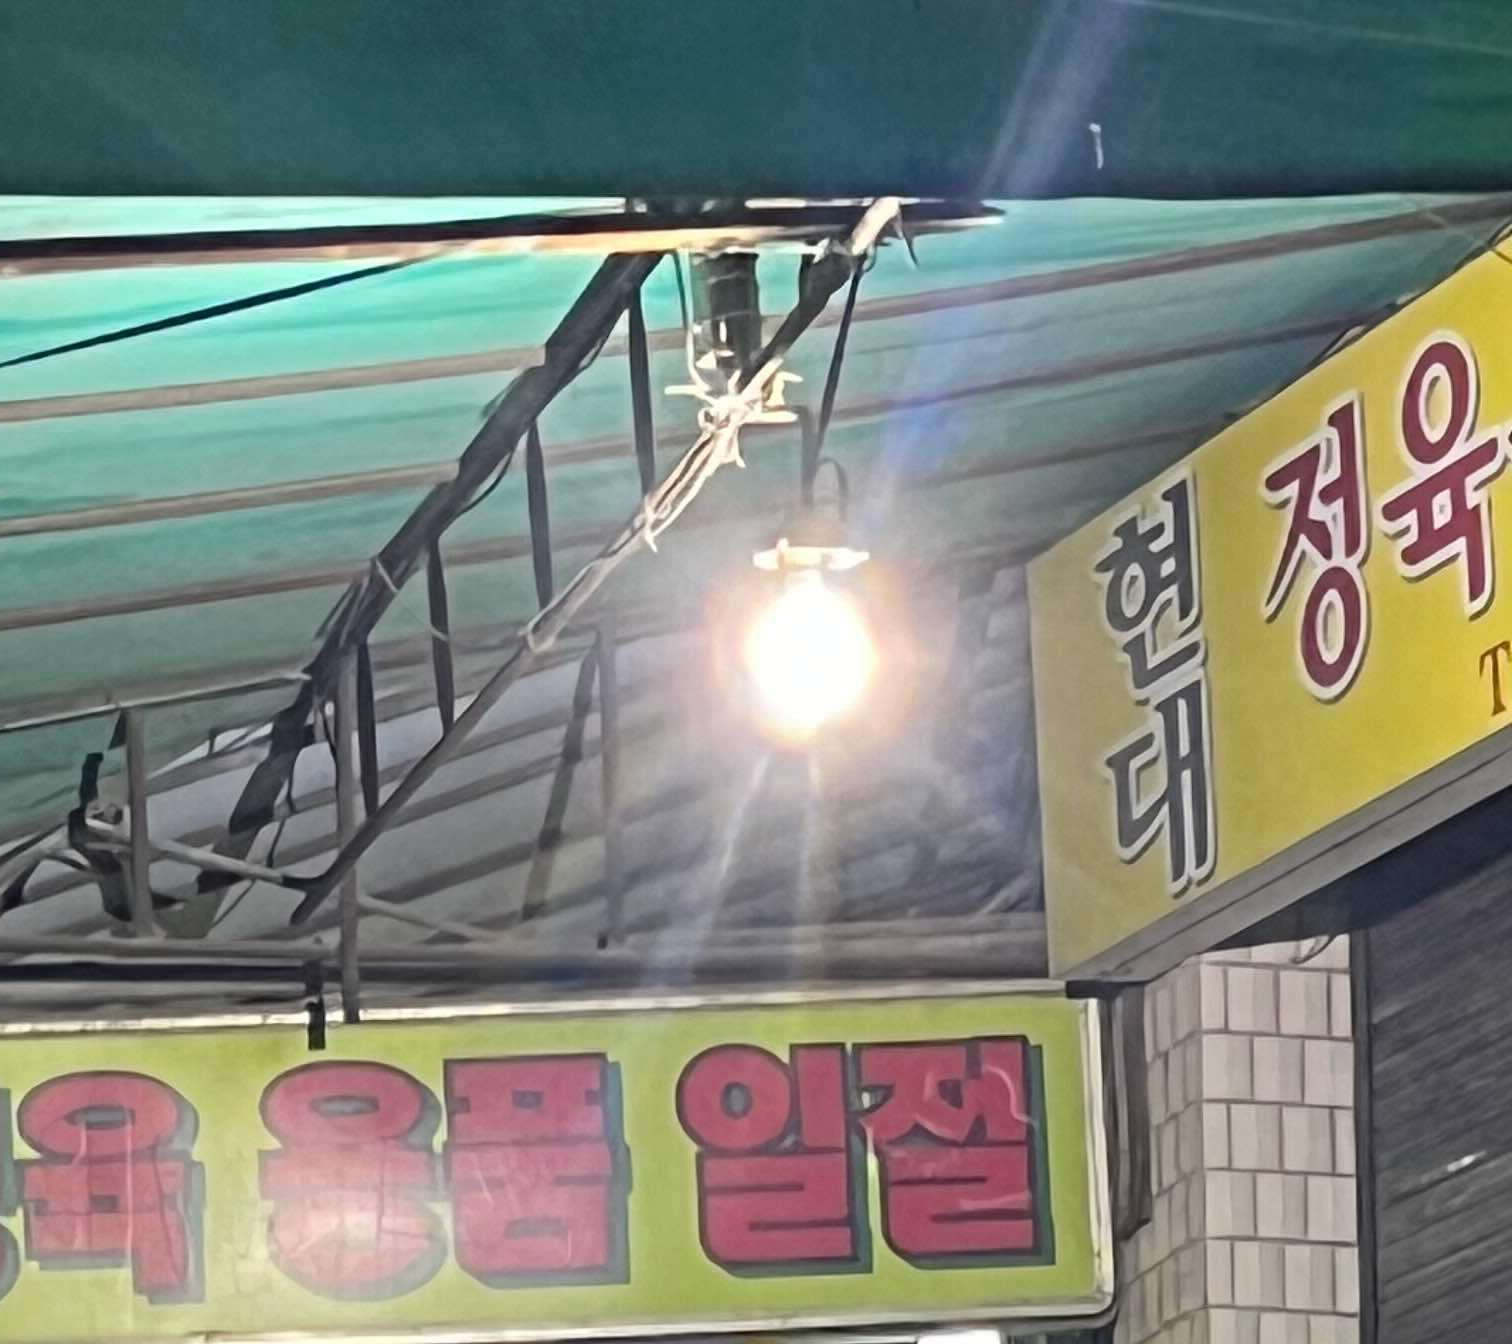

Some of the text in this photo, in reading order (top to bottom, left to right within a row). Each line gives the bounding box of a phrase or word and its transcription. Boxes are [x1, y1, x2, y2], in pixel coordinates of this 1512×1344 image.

[1093, 476, 1212, 892] 현대
[258, 1052, 630, 1300] 용품
[675, 1032, 1055, 1278] 일절
